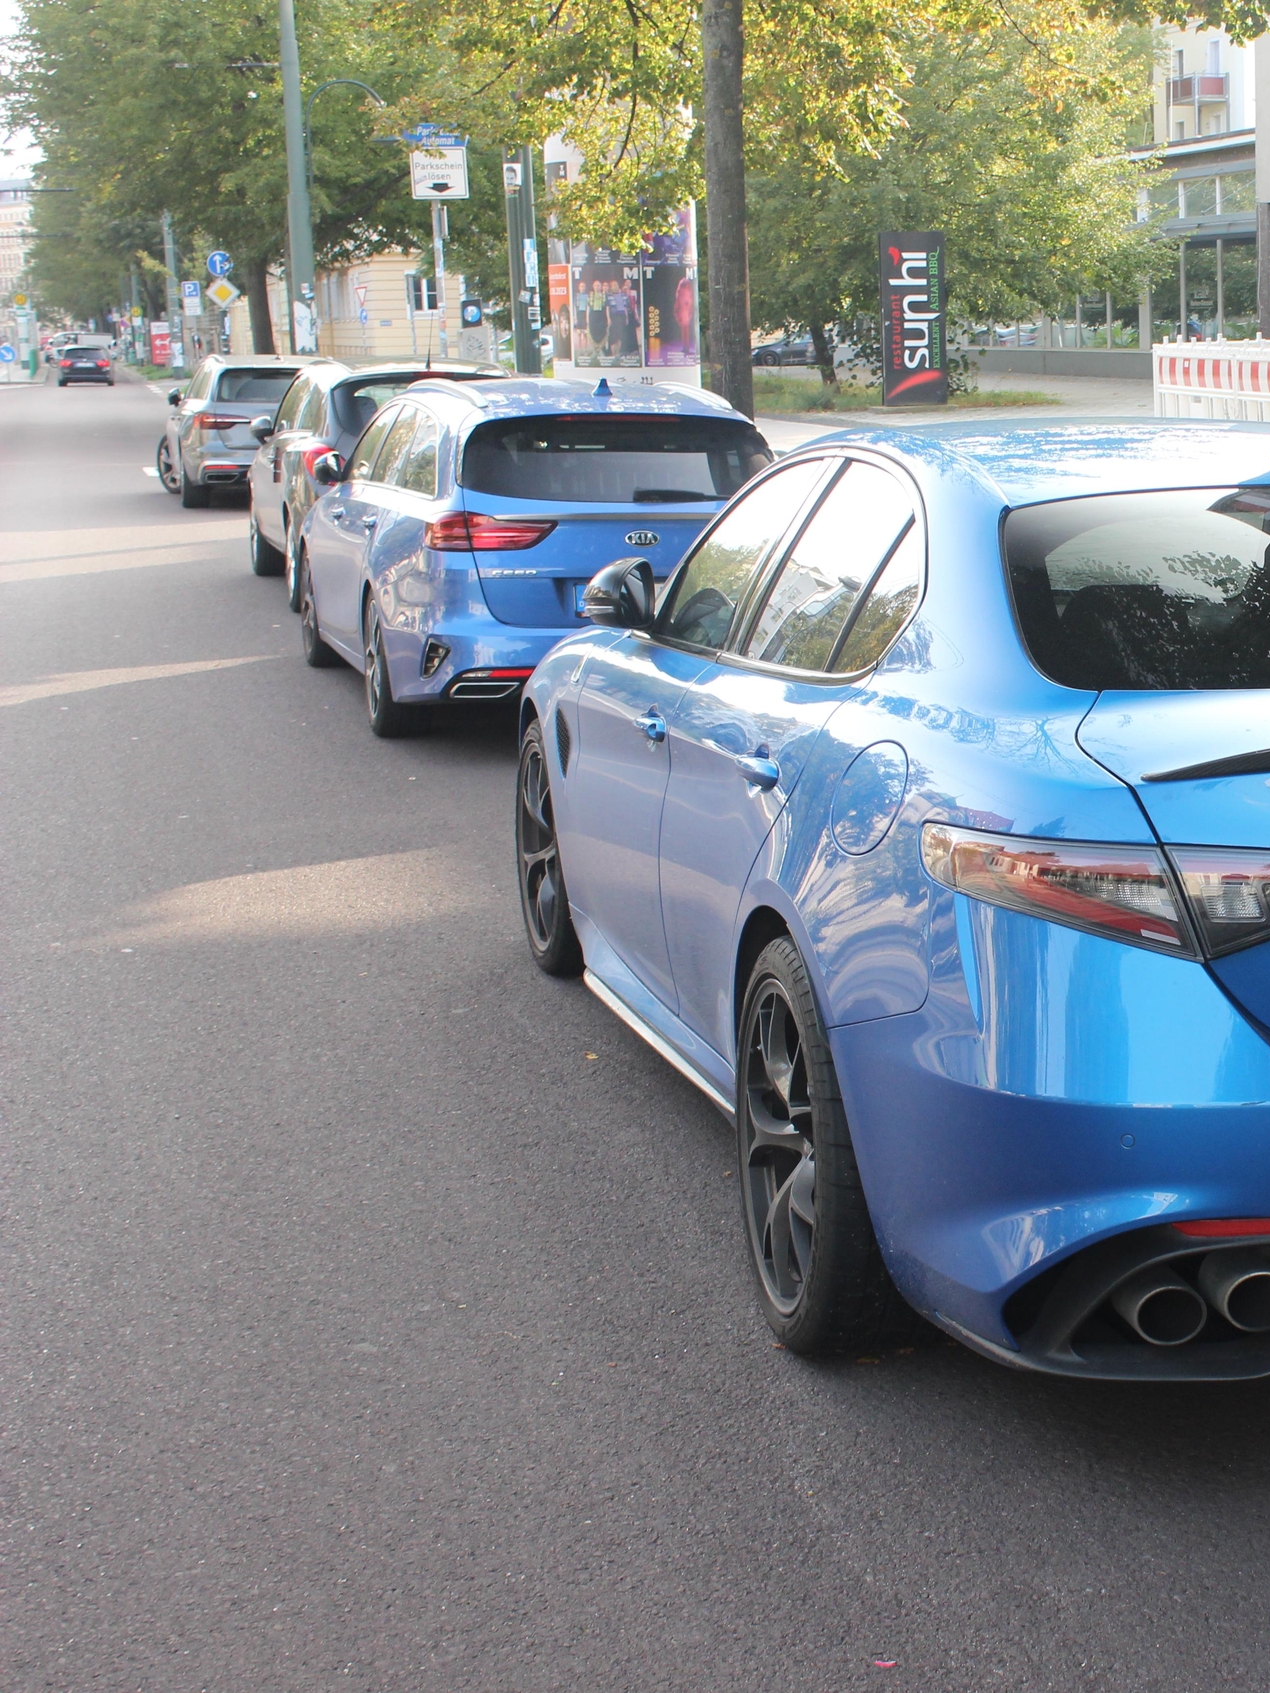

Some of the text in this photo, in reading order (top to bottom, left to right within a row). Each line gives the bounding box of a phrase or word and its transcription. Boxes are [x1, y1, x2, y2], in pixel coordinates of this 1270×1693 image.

[414, 162, 463, 171] Parkschein
[427, 172, 452, 180] lösen
[623, 266, 639, 280] M
[887, 248, 941, 369] sun hi
[929, 246, 941, 369] EXCELLENT ASIAN BBQ
[890, 295, 902, 370] restaurant
[631, 533, 655, 544] KIA
